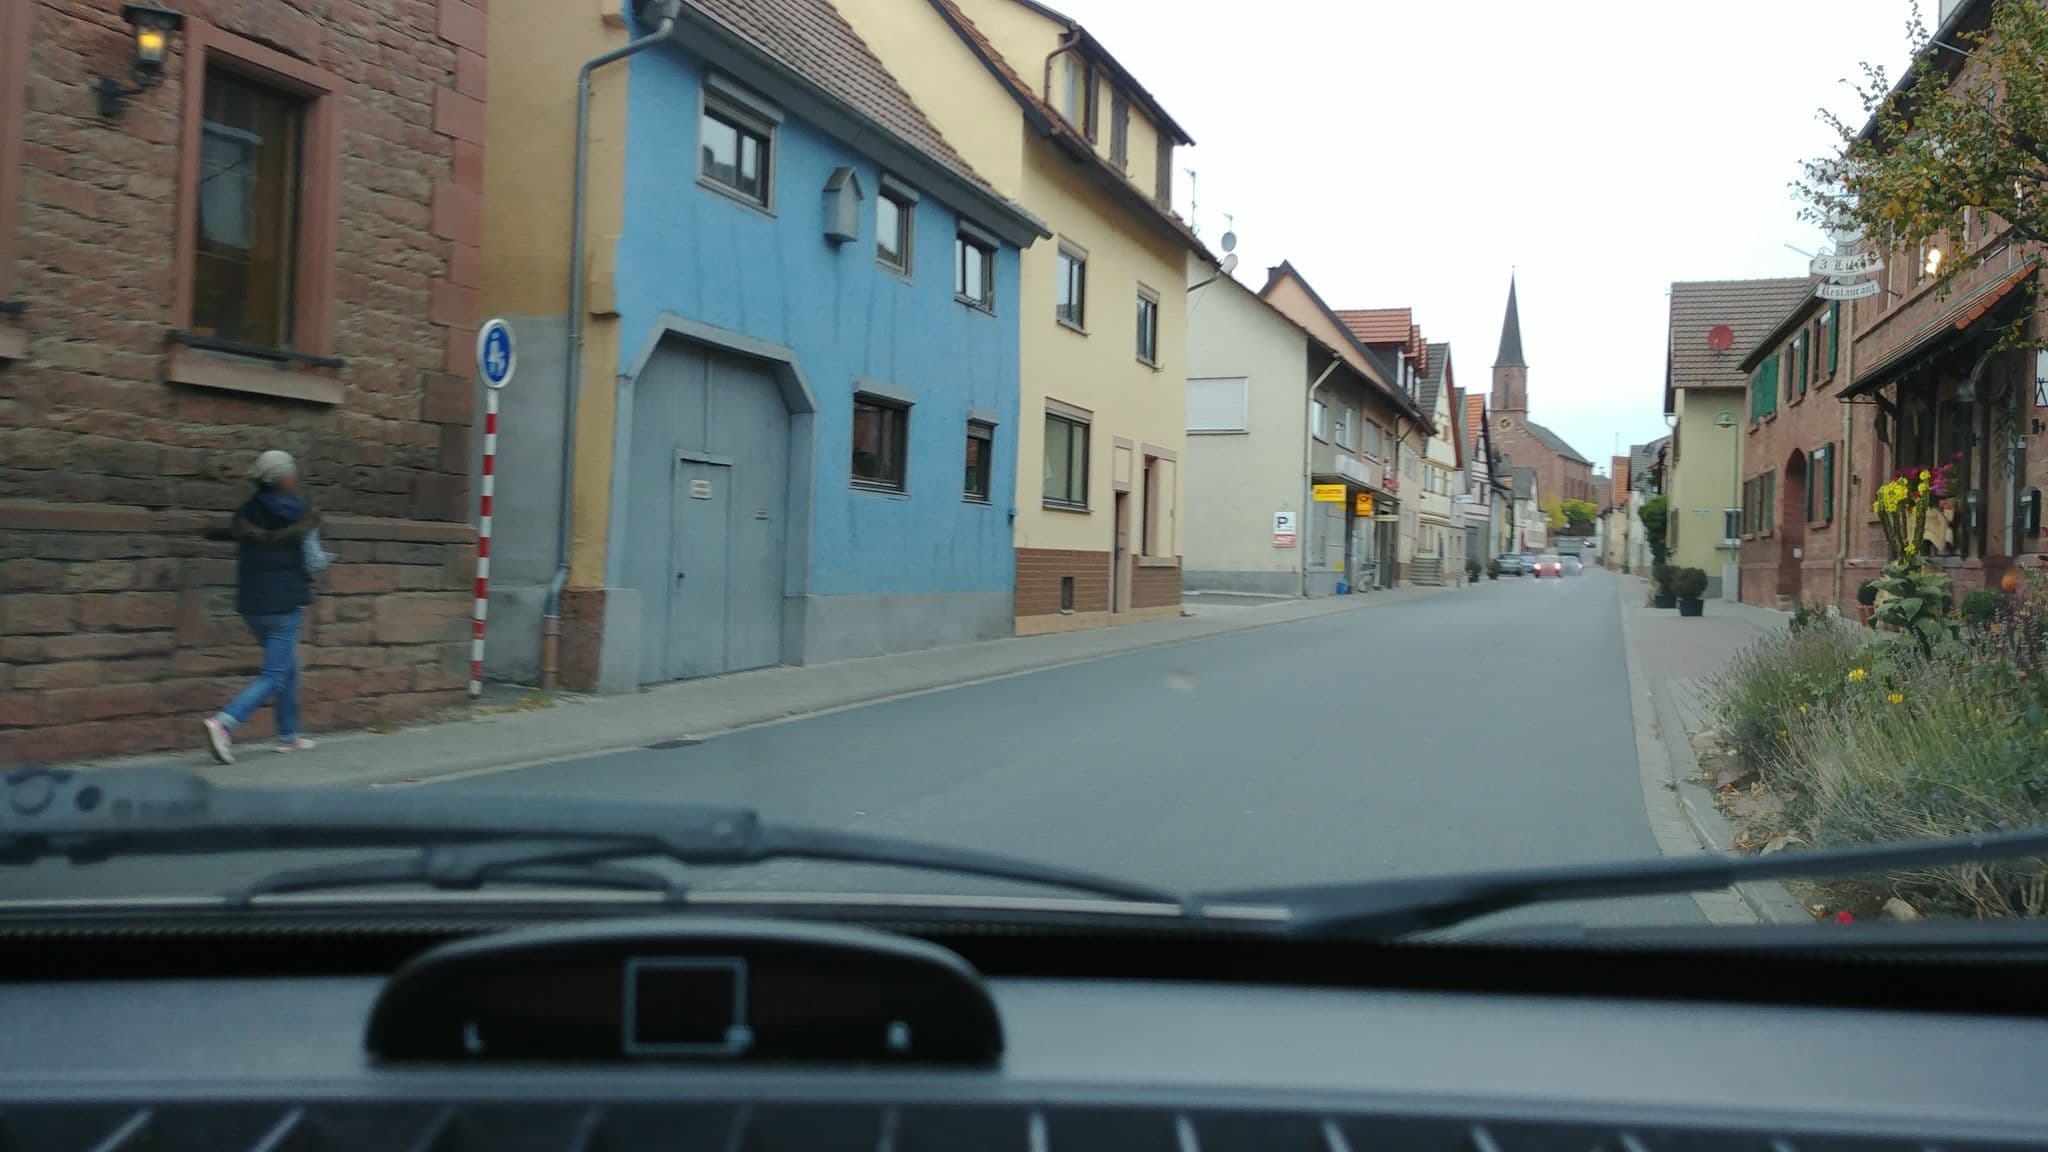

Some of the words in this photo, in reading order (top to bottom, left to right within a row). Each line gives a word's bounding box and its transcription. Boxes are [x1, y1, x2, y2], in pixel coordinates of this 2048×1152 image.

[1819, 258, 1828, 270] 3
[1820, 284, 1876, 297] Restaurant
[1277, 516, 1289, 528] P
